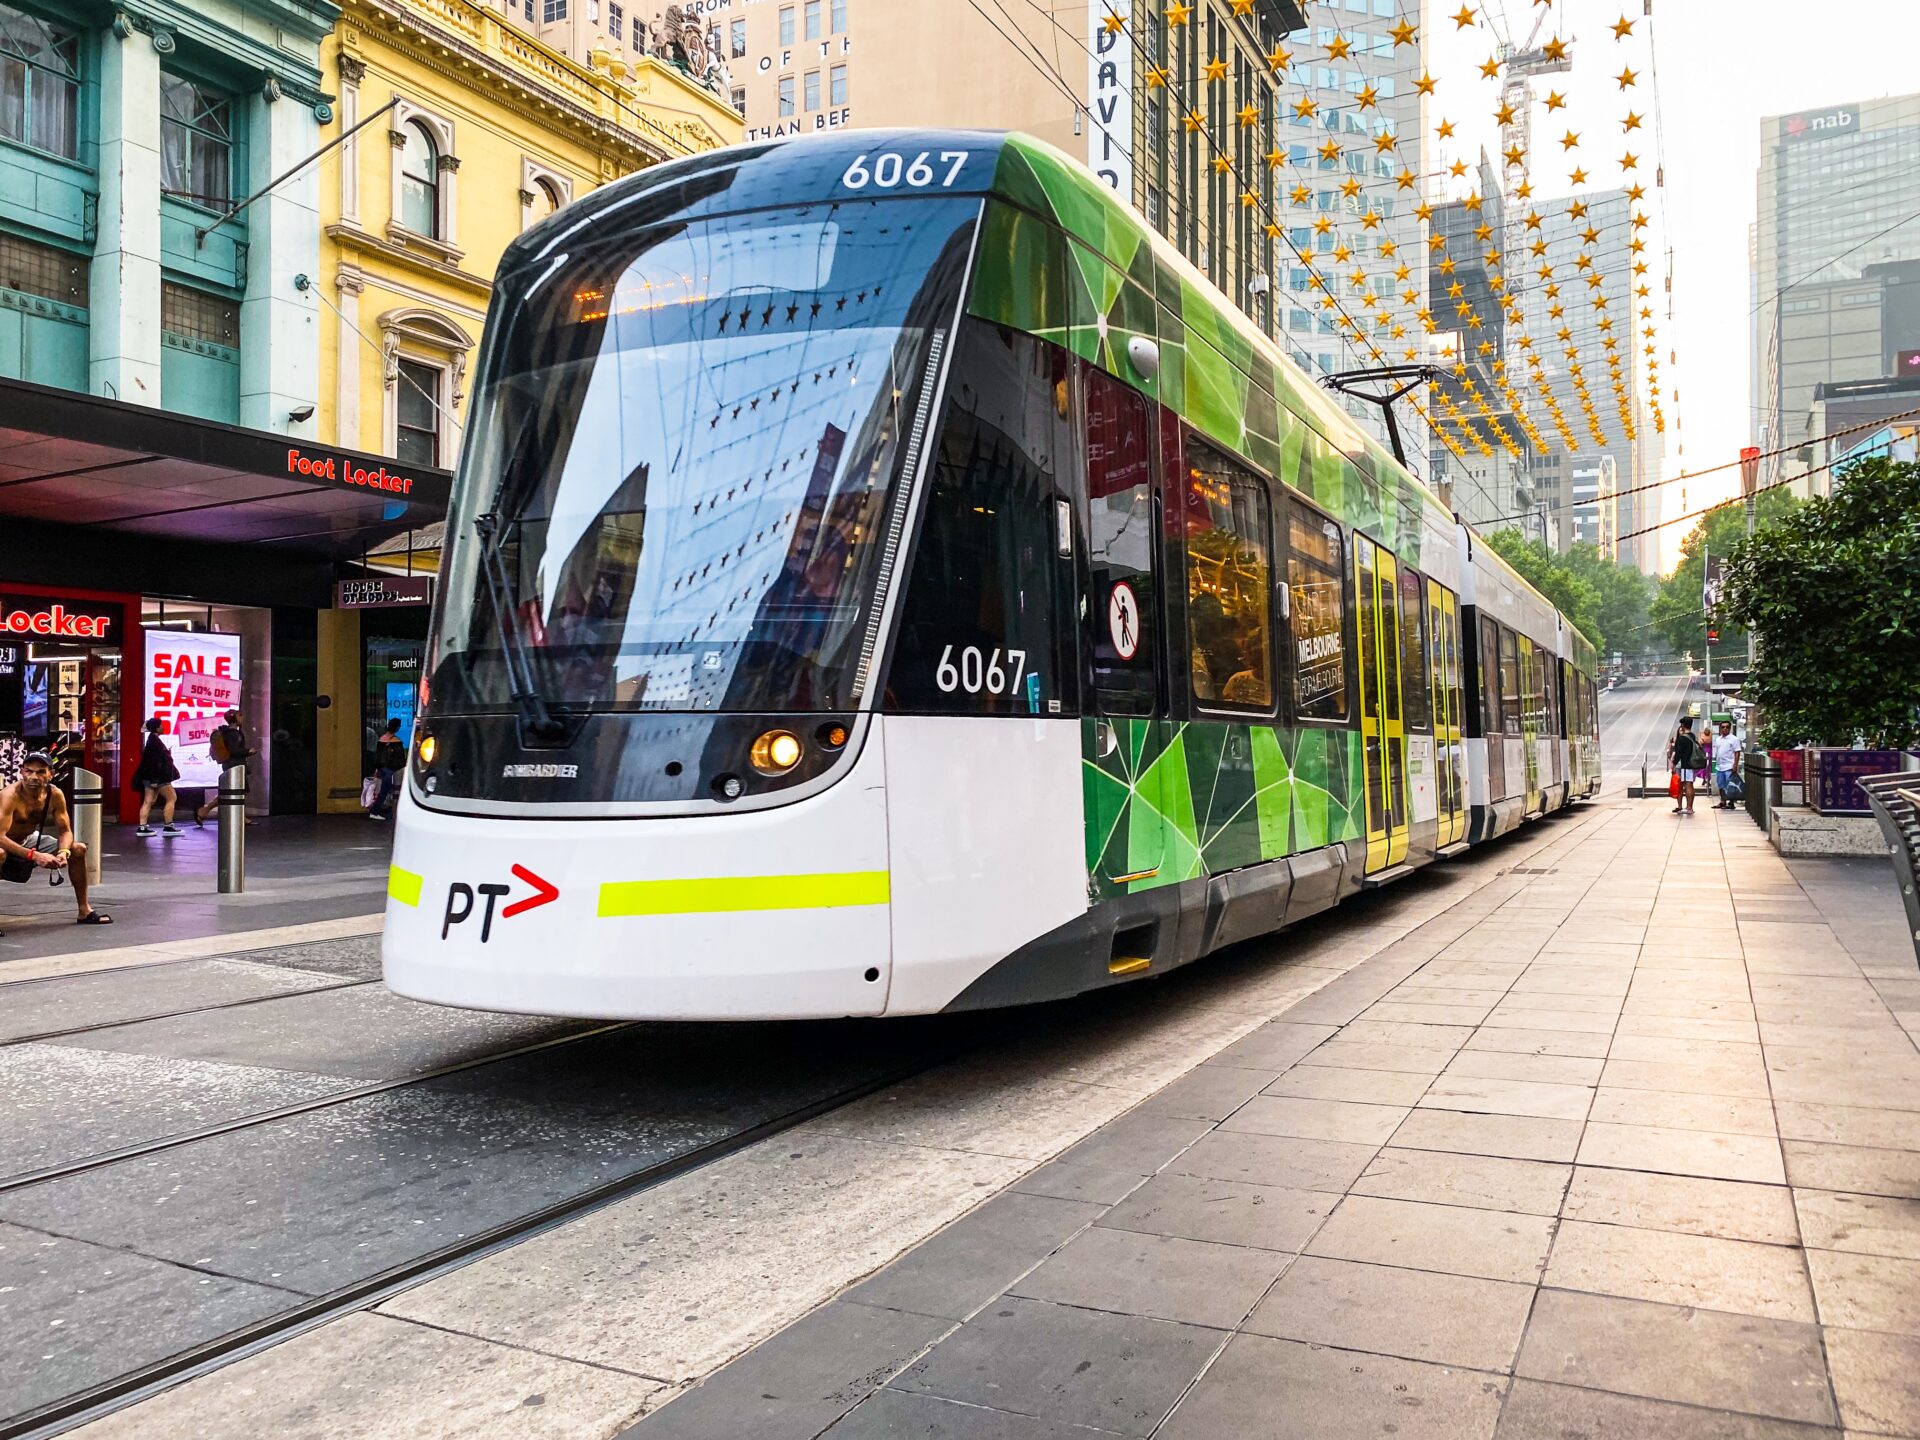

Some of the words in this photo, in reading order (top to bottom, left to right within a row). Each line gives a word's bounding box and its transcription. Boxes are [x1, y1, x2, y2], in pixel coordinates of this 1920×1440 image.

[760, 50, 791, 70] OF
[749, 119, 800, 141] THAN
[1811, 111, 1852, 131] nab
[842, 151, 969, 189] 6067
[288, 449, 336, 481] Foot
[343, 460, 413, 494] Locker
[343, 581, 383, 594] HOUSE
[1298, 631, 1341, 665] MELBOURNE
[154, 653, 231, 679] SALE
[936, 645, 1026, 695] 6067
[154, 682, 231, 708] SA
[190, 684, 212, 697] 50%
[214, 688, 231, 700] OFF
[188, 729, 211, 741] 50%
